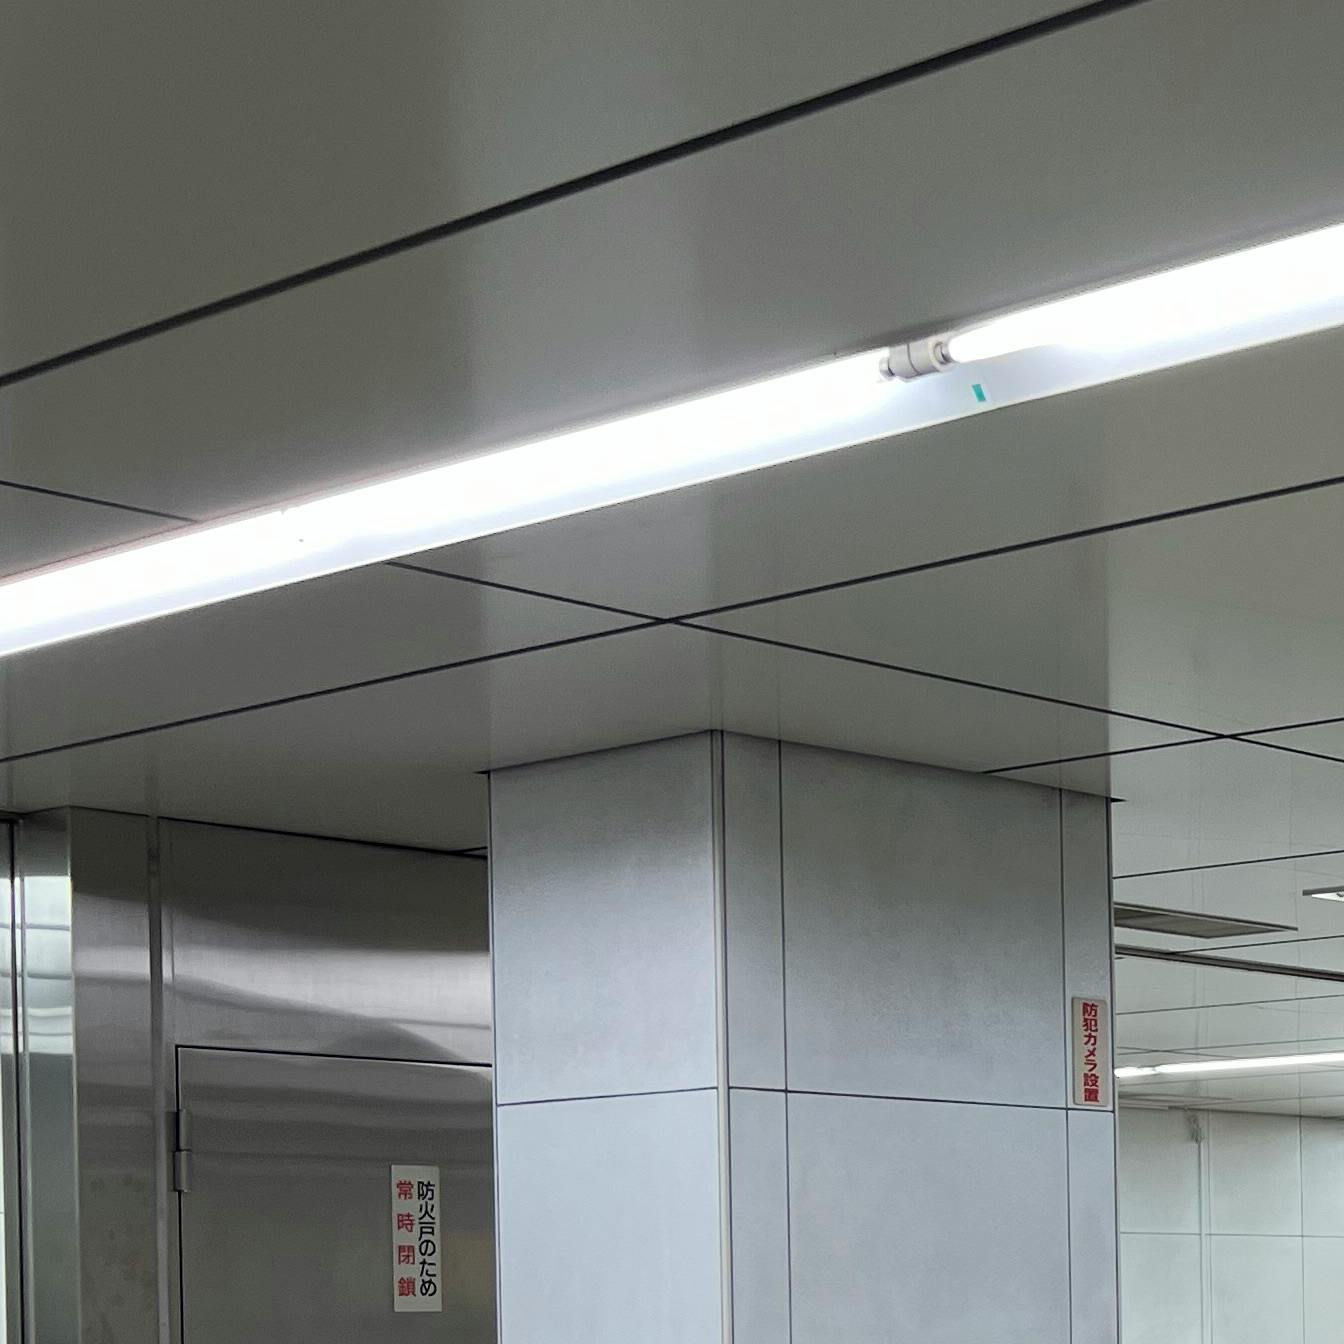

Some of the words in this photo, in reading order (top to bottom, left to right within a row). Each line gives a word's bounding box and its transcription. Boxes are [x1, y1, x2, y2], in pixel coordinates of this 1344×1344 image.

[1082, 1001, 1100, 1103] 防犯カメラ設置
[396, 1179, 417, 1297] 常時閉鎖
[417, 1180, 437, 1297] 防火戸のため
